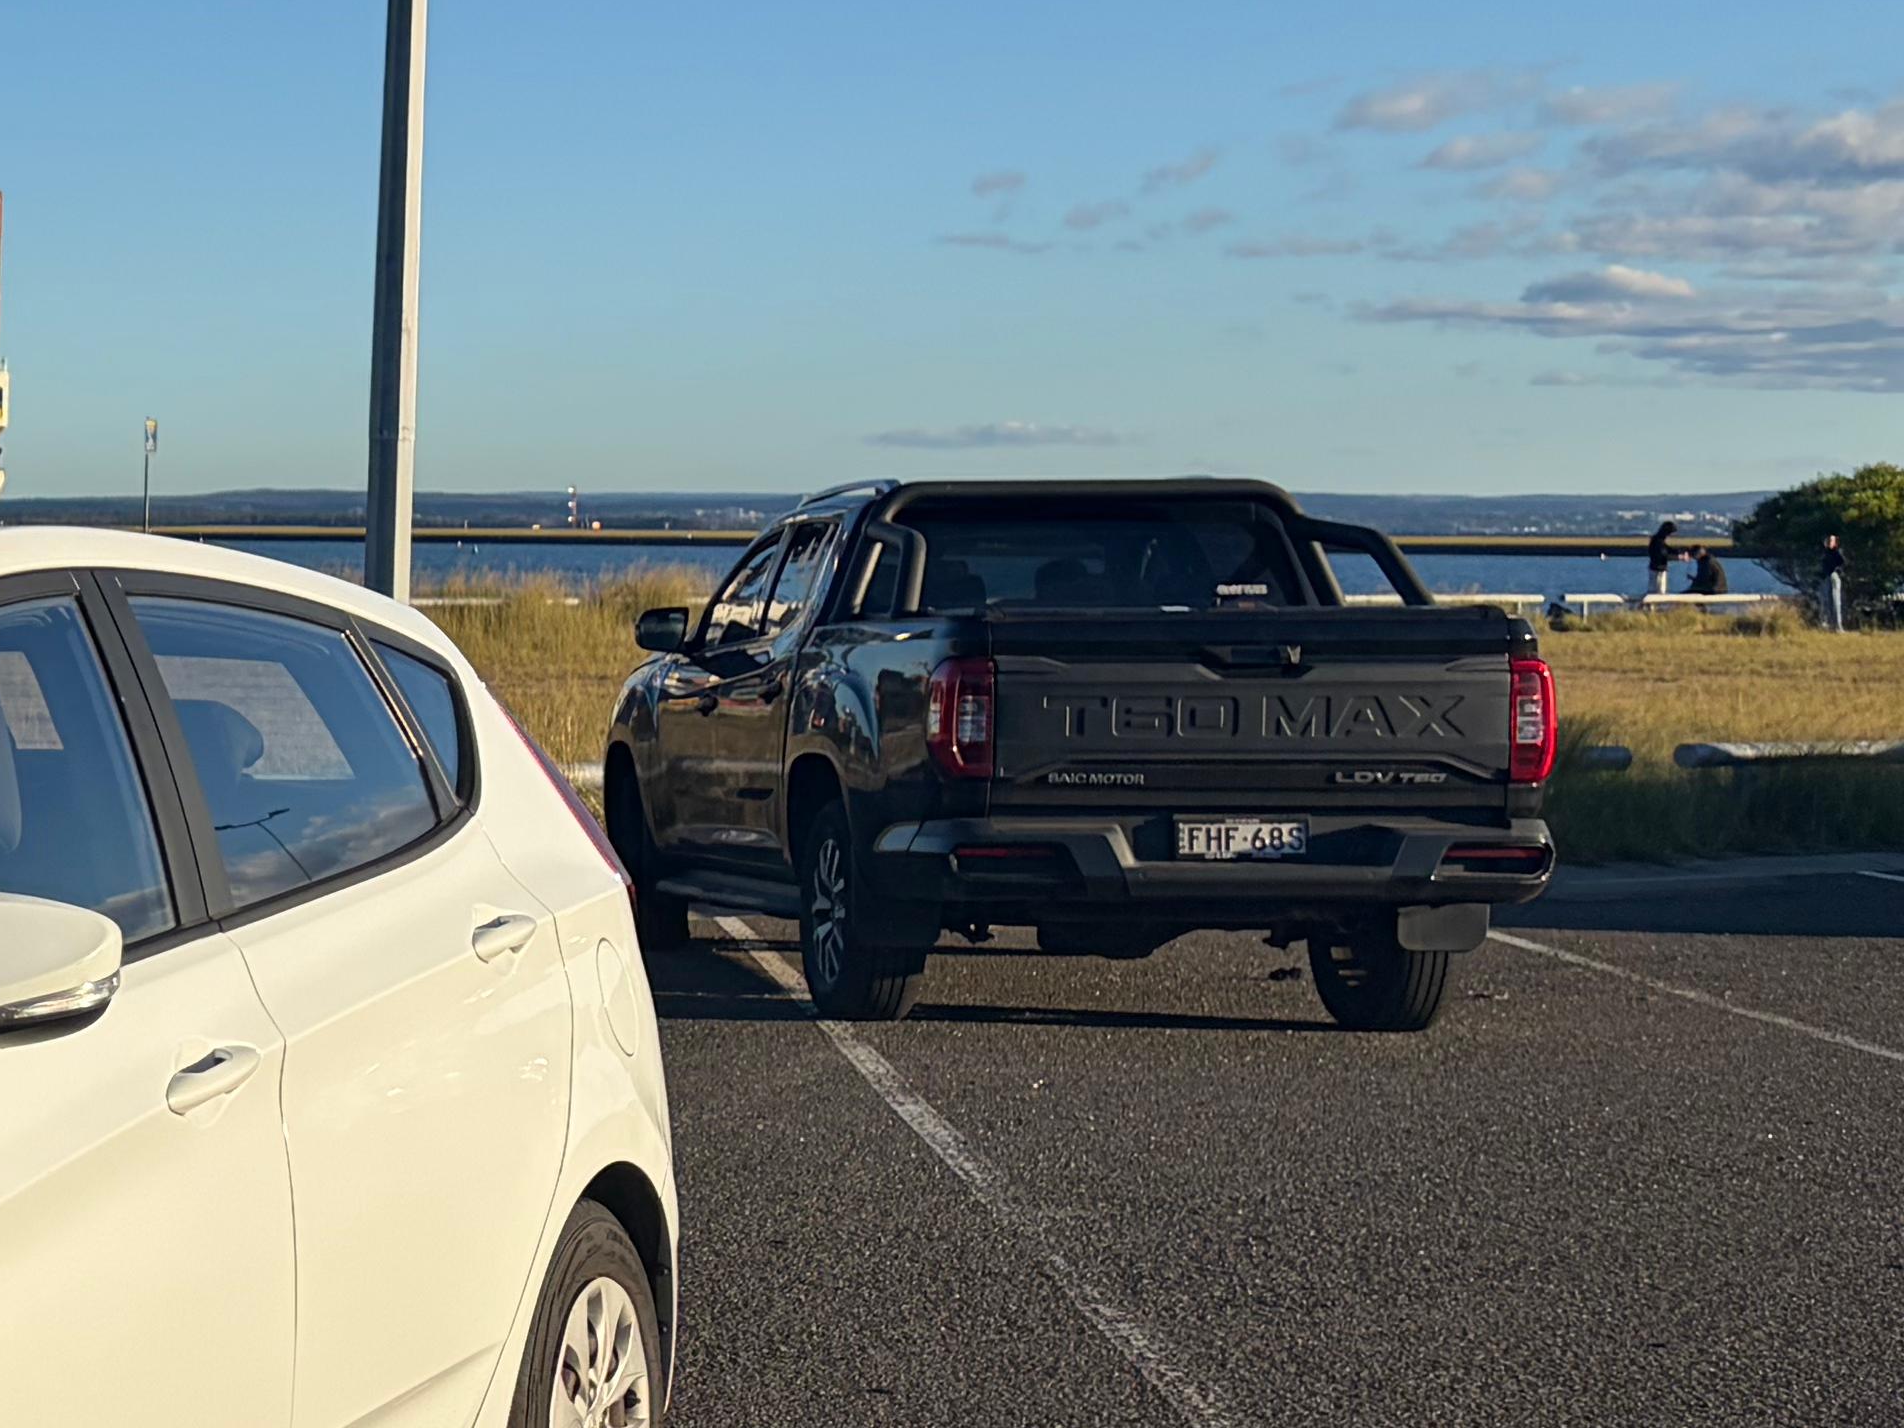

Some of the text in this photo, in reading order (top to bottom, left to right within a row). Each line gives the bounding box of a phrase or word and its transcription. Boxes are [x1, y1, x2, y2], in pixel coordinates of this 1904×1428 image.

[1043, 695, 1466, 738] T60 MAX
[1047, 771, 1146, 786] SAIC MOTOR
[1334, 770, 1395, 785] LDV
